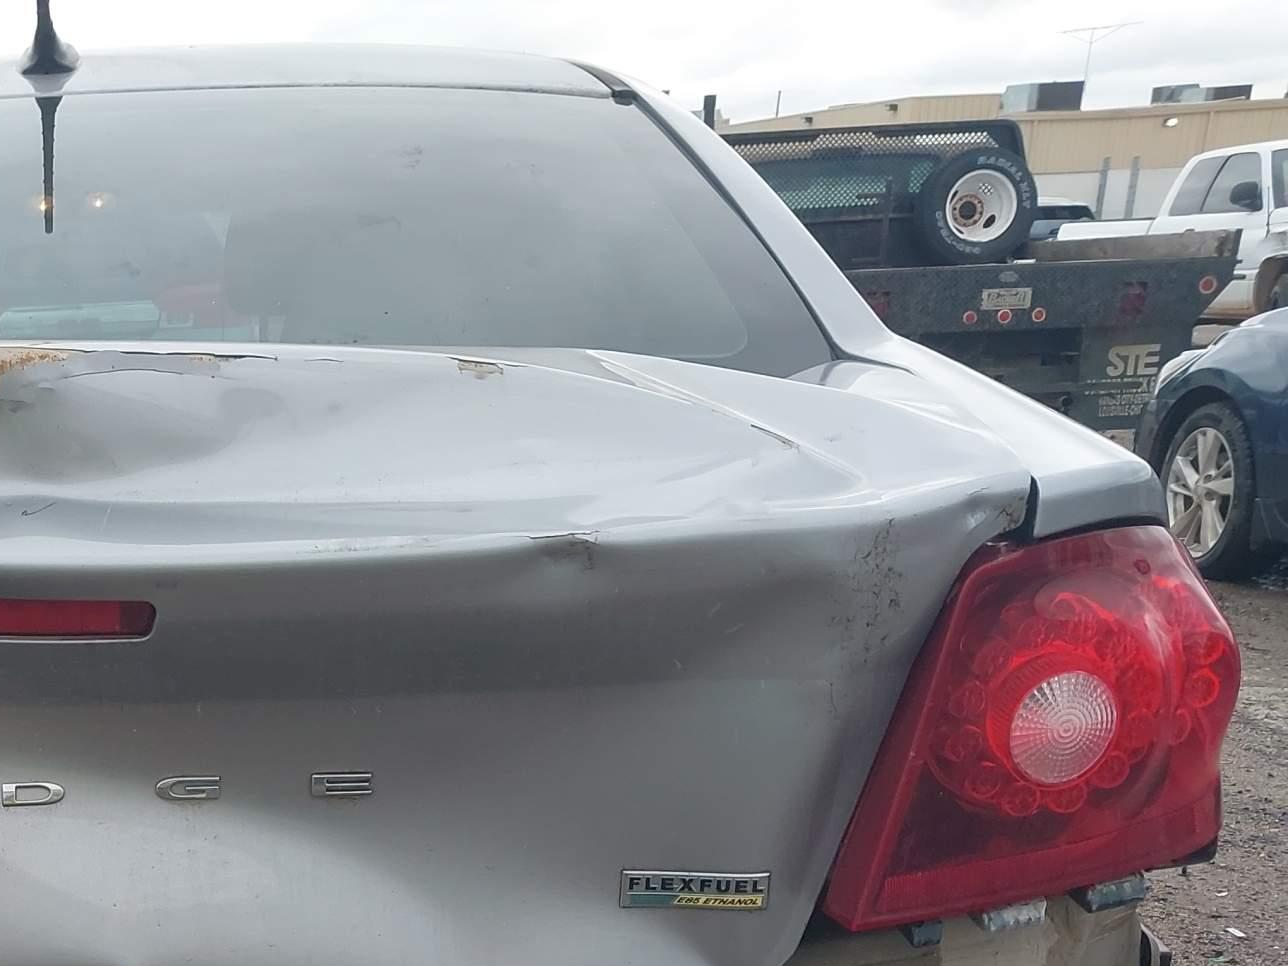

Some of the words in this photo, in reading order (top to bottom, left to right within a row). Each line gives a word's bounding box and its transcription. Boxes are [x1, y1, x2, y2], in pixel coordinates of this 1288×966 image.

[627, 876, 766, 893] FLEXFUEL
[676, 896, 700, 905] E85
[702, 897, 760, 906] ETHANOL
